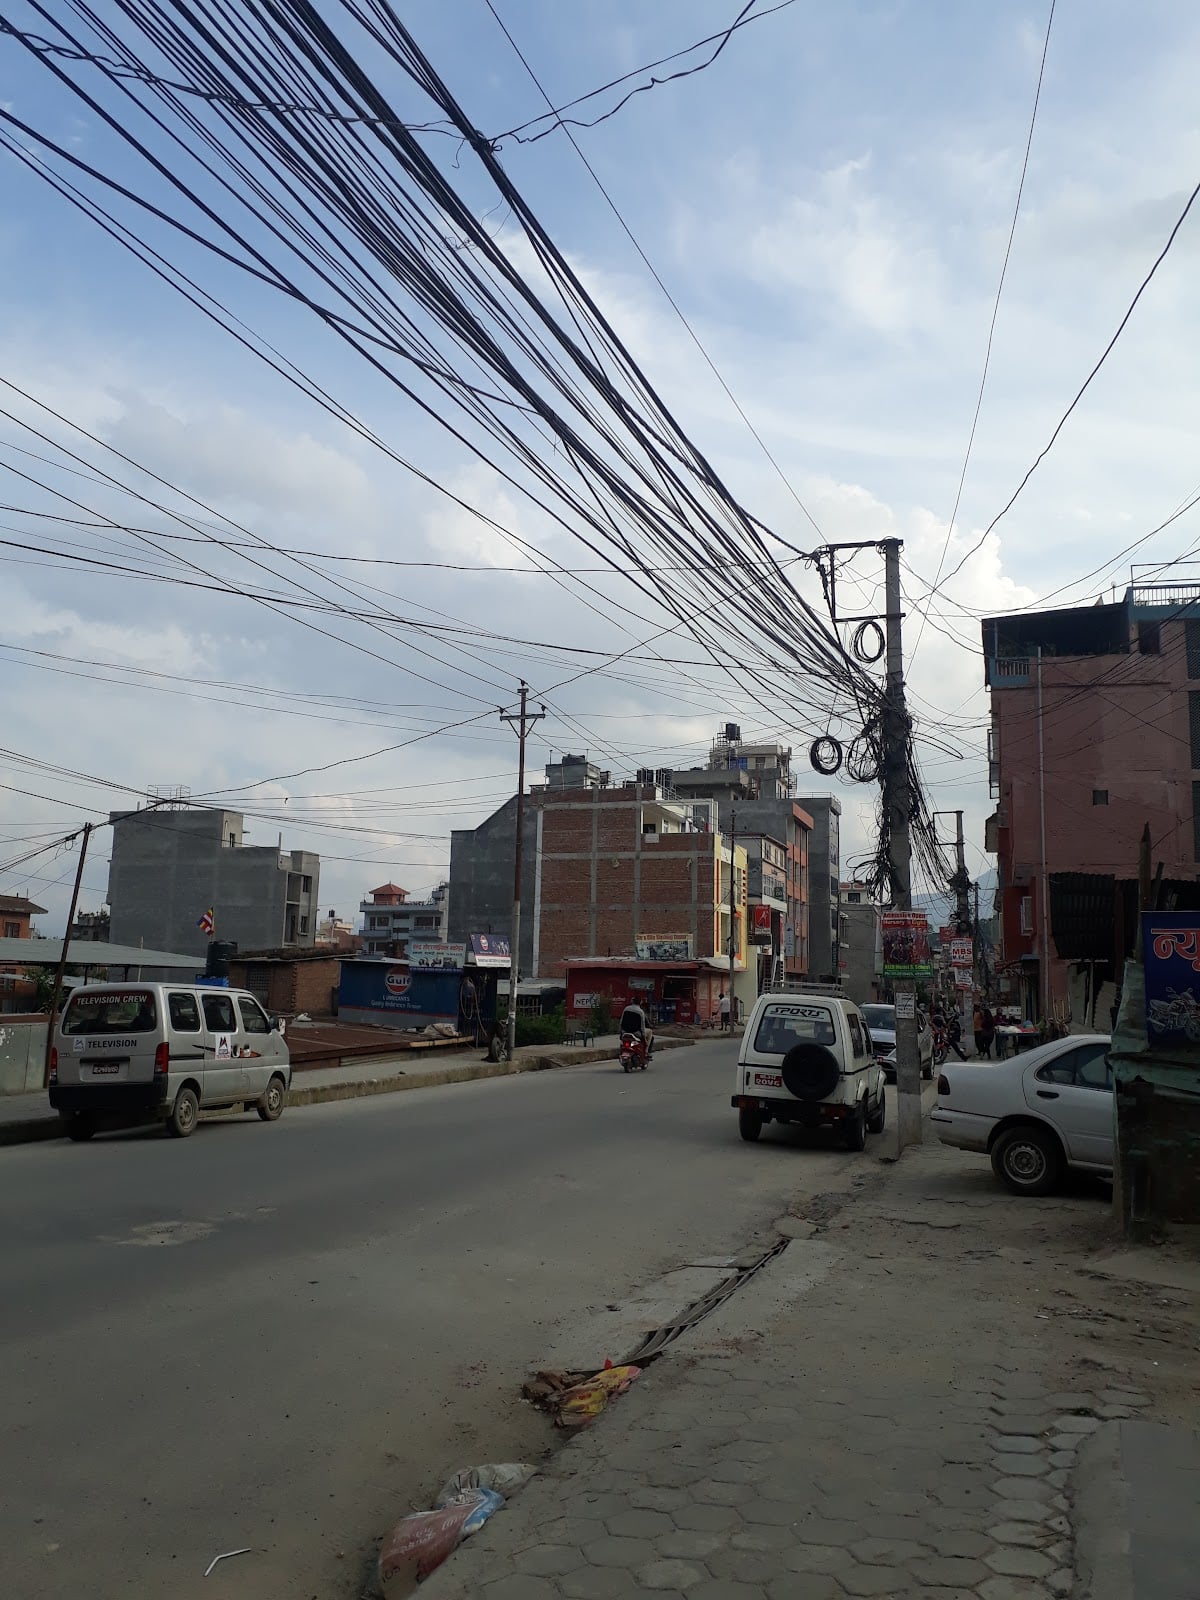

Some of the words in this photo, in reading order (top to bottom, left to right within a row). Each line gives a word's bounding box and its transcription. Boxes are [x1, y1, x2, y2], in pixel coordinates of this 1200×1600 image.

[387, 975, 410, 985] Gulf
[77, 996, 120, 1005] TELEVISION
[122, 995, 147, 1003] CREW
[771, 1007, 824, 1018] SPORTS
[87, 1039, 137, 1048] TELEVISION
